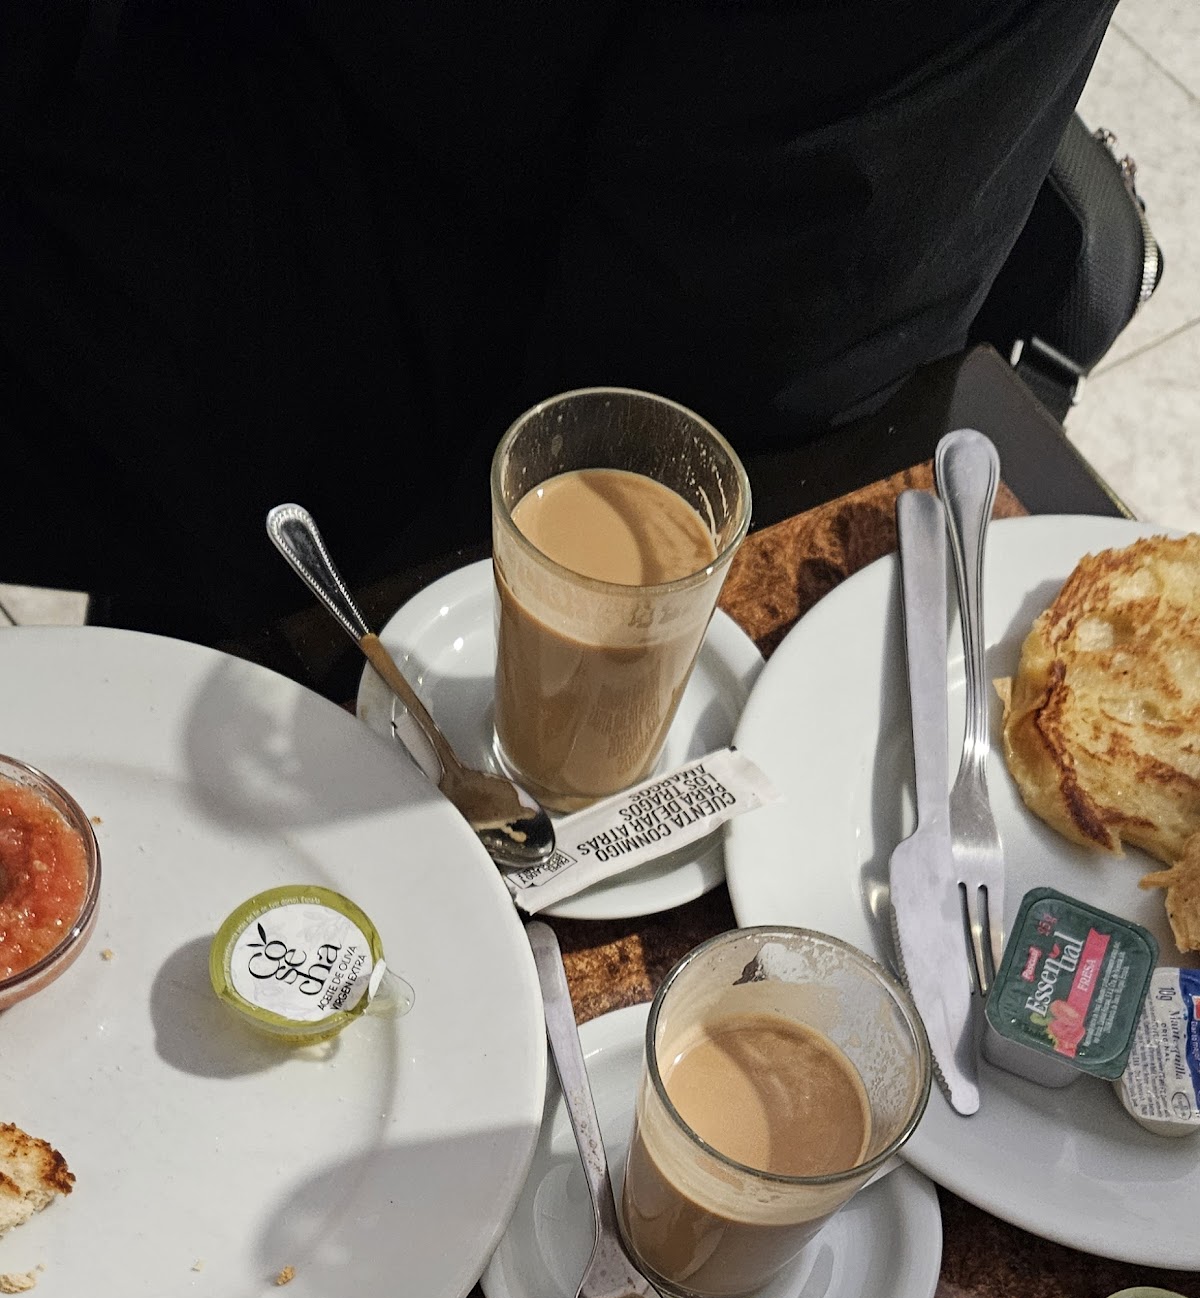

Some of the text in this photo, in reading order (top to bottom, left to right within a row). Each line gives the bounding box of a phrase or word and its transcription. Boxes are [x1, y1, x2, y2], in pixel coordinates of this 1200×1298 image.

[619, 773, 717, 821] LOS TRAGOS
[628, 764, 707, 802] AMARGOS
[576, 783, 727, 856] PARA DEJAR ATRAS
[595, 792, 736, 862] CUENTA CONMIGO
[317, 945, 357, 1011] ACEITE DE OLIVA
[330, 954, 368, 1010] VIRGEN EXTRA
[1077, 958, 1097, 992] FRESA
[1156, 986, 1176, 1001] 10g
